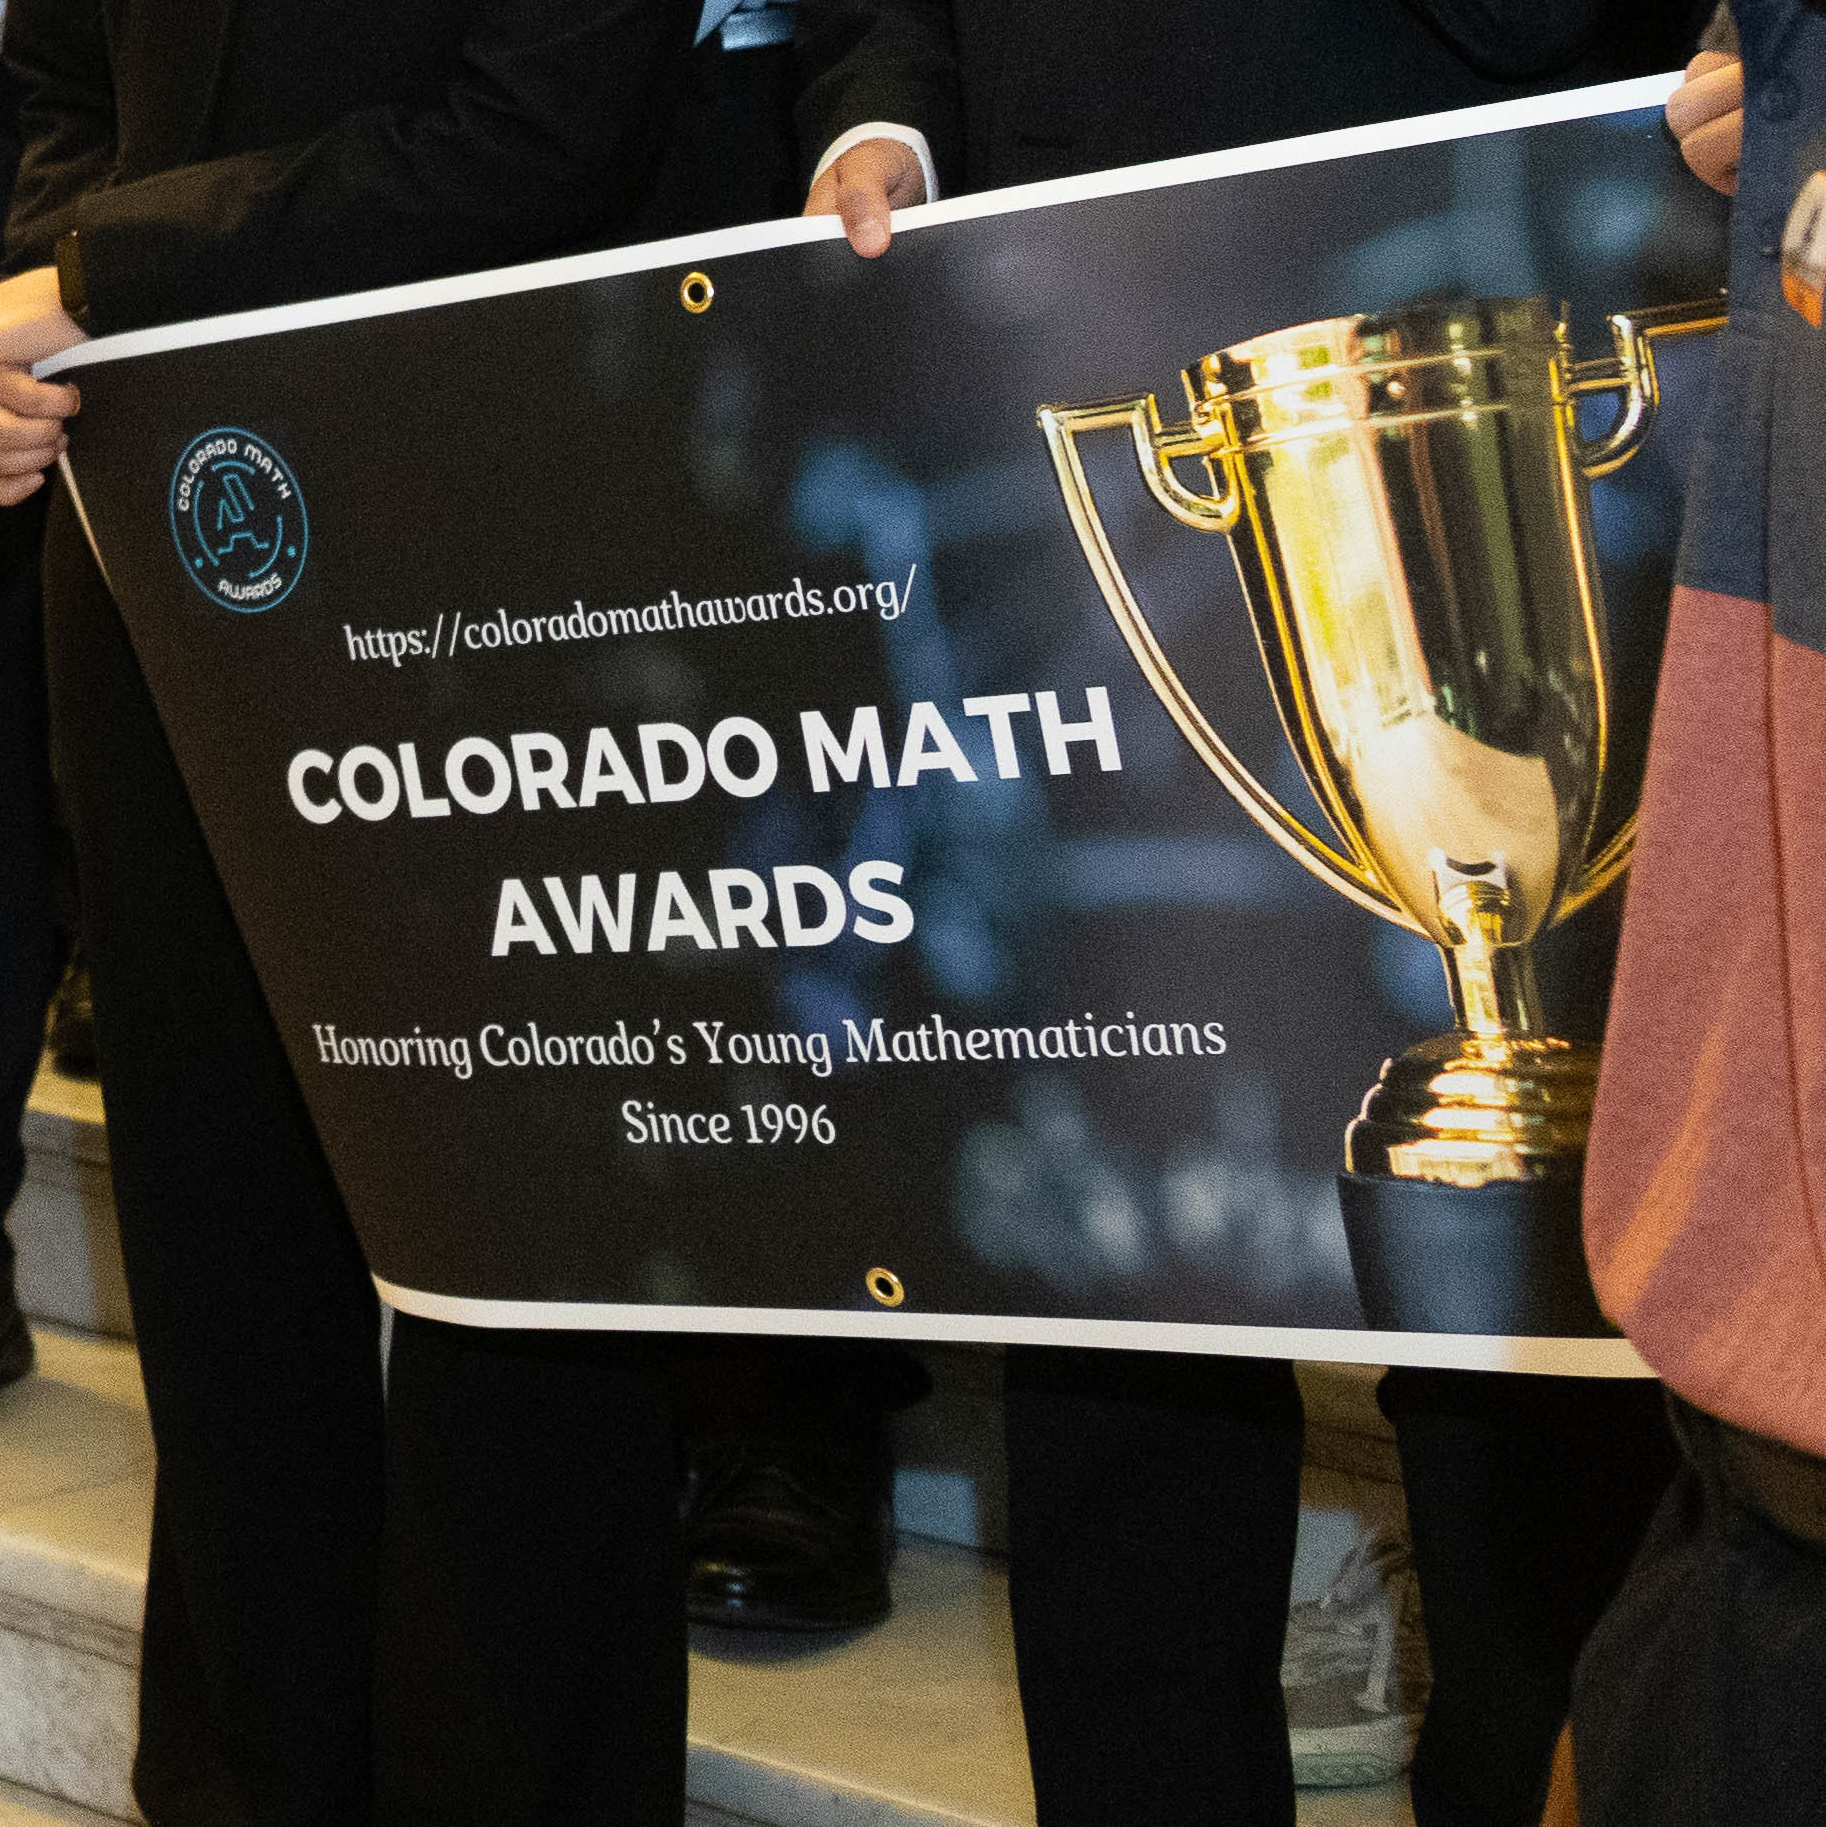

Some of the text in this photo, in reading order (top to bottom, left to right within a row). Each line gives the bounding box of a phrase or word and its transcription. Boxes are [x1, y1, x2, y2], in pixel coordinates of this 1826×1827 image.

[178, 438, 292, 512] COLORADO MATH
[219, 572, 283, 600] AWARDS
[343, 563, 916, 667] https://coloradomathawards.org/
[288, 686, 1122, 824] COLORADO MATH
[492, 860, 914, 956] AWARDS
[313, 1011, 1226, 1079] Honoring Colorado's Young Mathematicians
[622, 1100, 835, 1144] Since 1996
